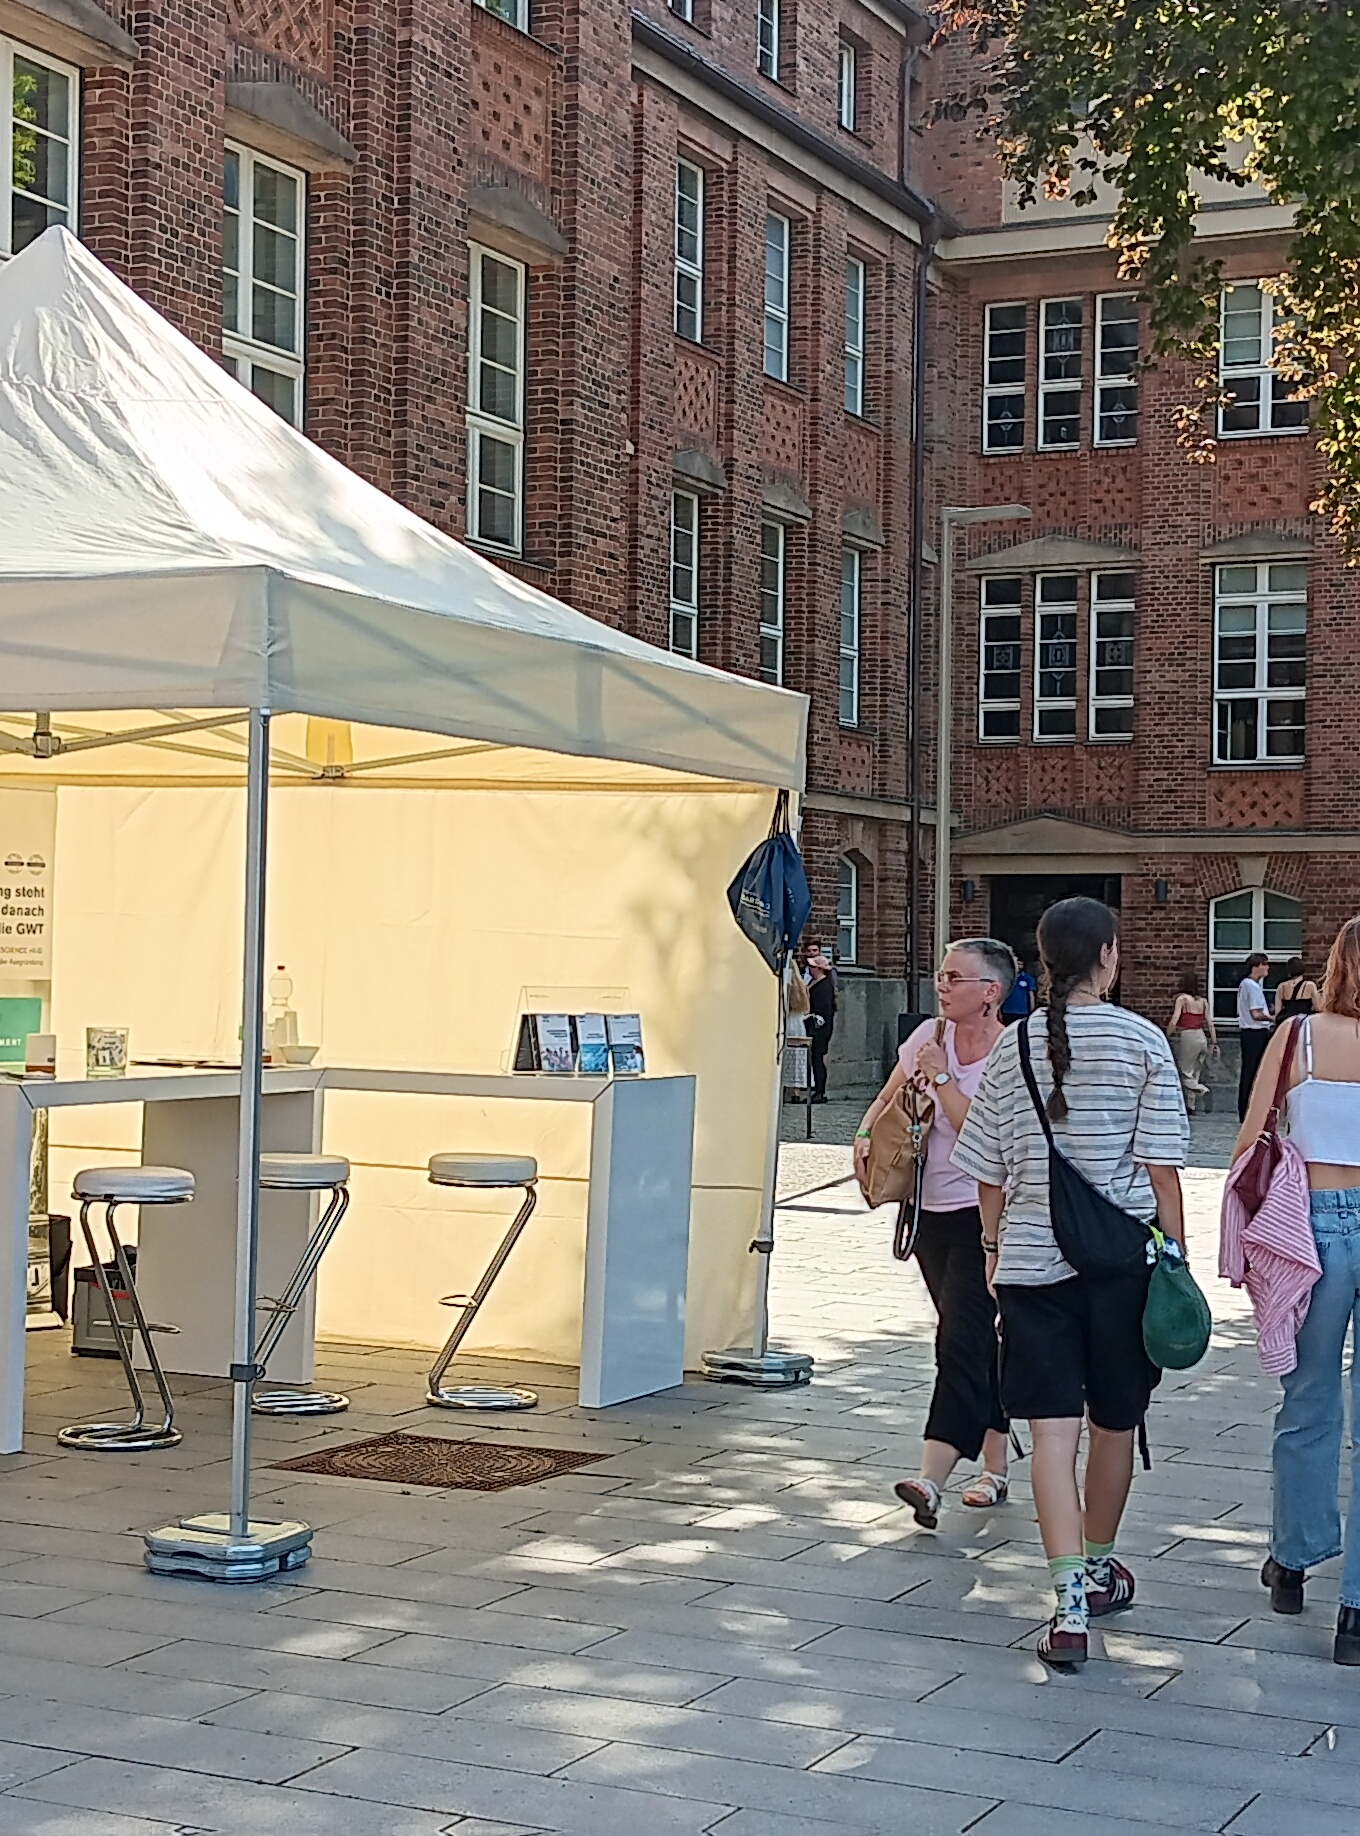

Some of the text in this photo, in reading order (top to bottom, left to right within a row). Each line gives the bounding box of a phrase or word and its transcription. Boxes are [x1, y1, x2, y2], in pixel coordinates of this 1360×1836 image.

[15, 886, 45, 899] steht
[1, 903, 45, 917] danach
[16, 922, 45, 935] GWT
